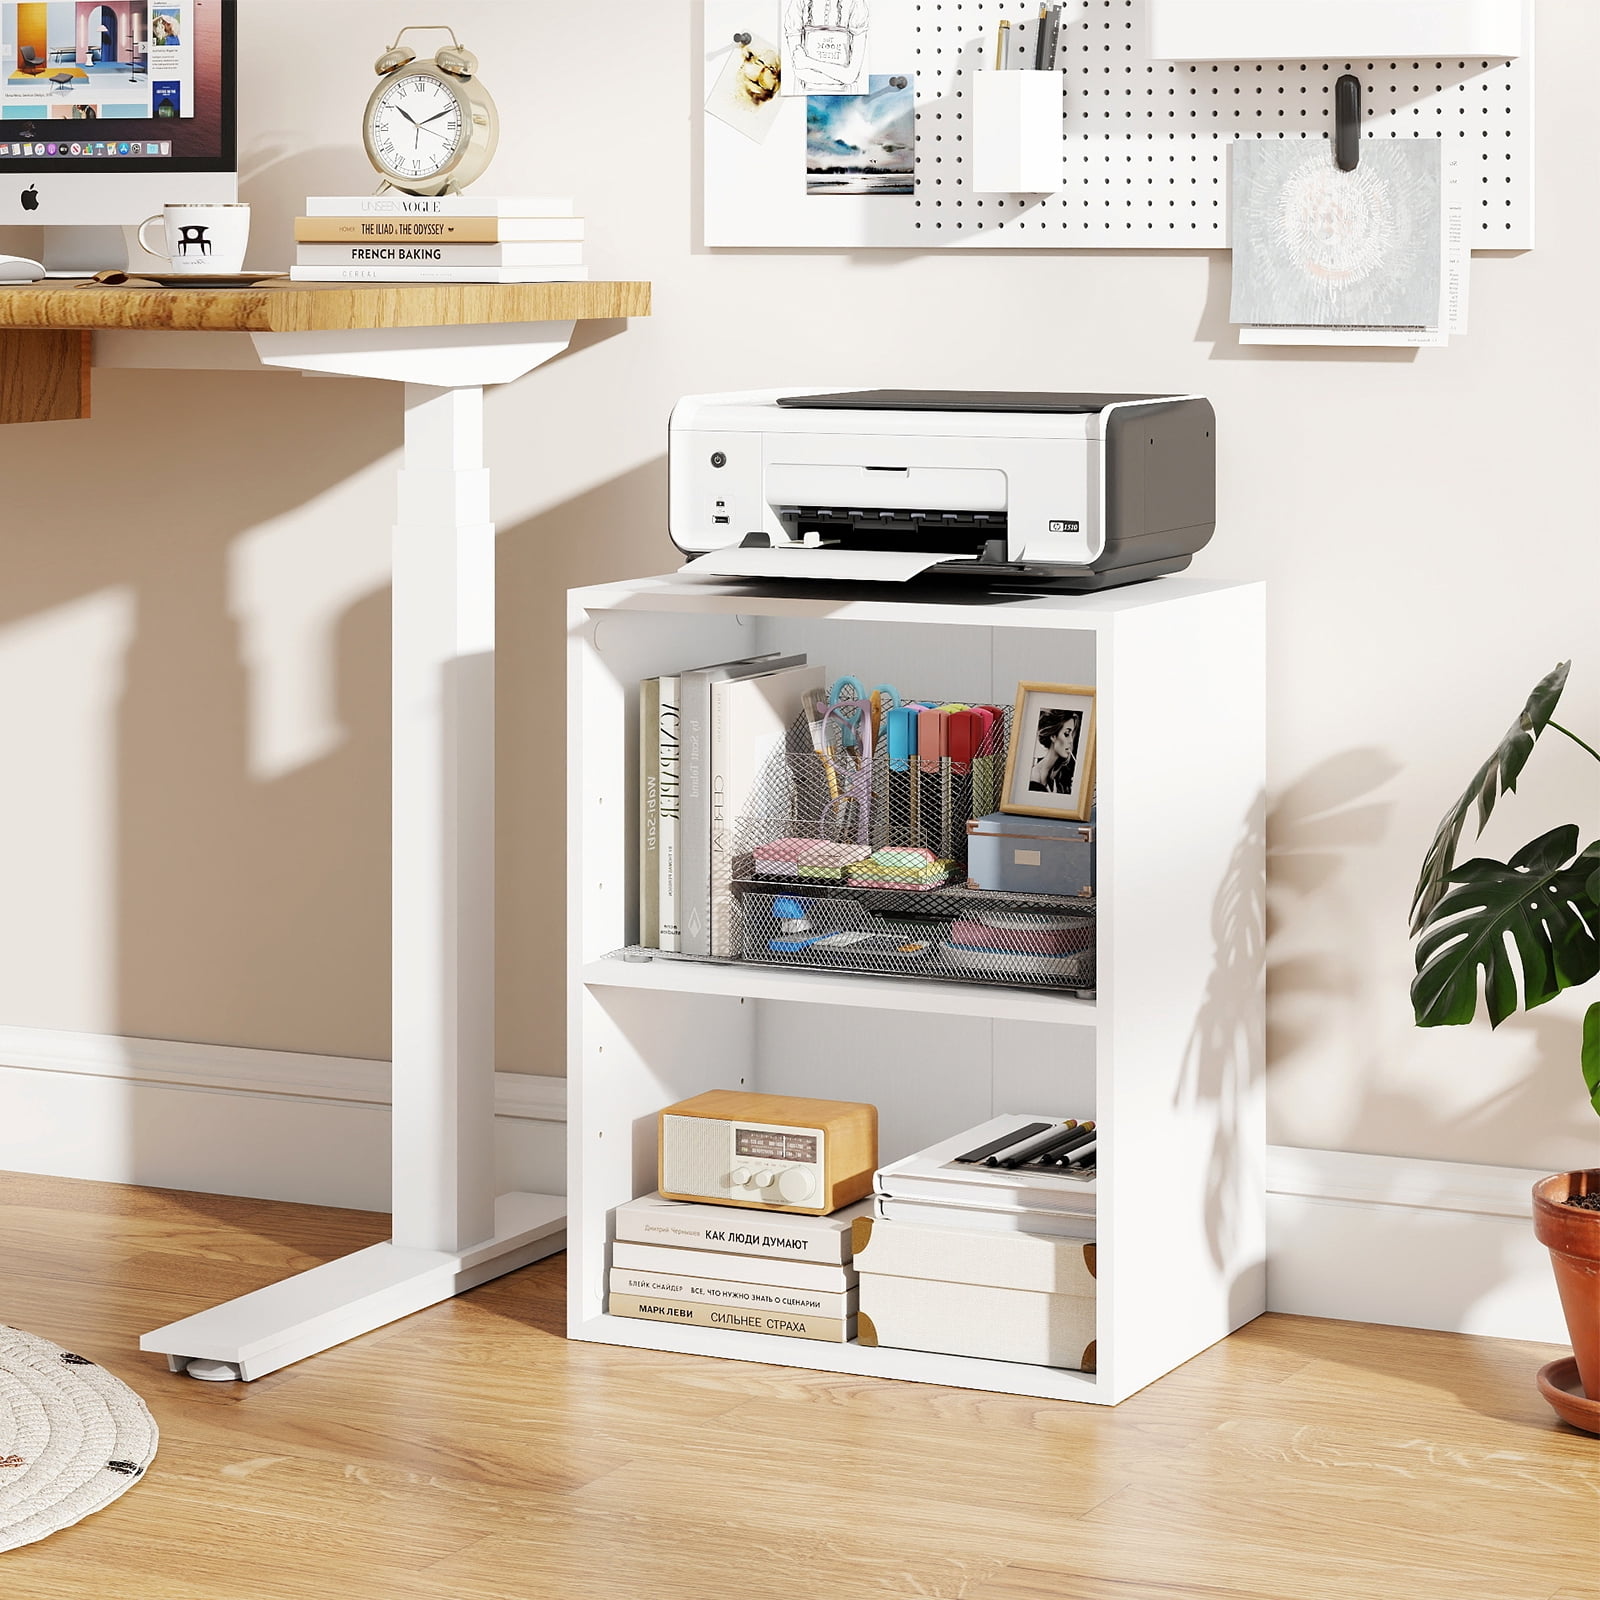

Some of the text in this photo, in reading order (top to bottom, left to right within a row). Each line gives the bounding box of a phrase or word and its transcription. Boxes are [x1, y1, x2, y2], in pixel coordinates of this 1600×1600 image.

[361, 200, 441, 212] UNSEEN VOGUE
[362, 223, 375, 235] THE
[376, 223, 394, 235] ILIAD
[399, 223, 412, 235] THE
[413, 223, 444, 235] ODYSSEY
[352, 248, 442, 260] FRENCH BAKING
[342, 270, 377, 278] CEREAL
[705, 1230, 808, 1250] КАК ЛЮДИ ДУМАЮТ
[628, 1280, 684, 1292] БЛЕЙК СНАЙДЕР
[690, 1287, 820, 1308] ВСЕ, ЧТО НУЖНО ЗНАТЬ О СЦЕНАРИИ
[639, 1304, 693, 1318] МАРК ЛЕВИ
[710, 1312, 806, 1332] СИЛЬНЕЕ СТРАХА
